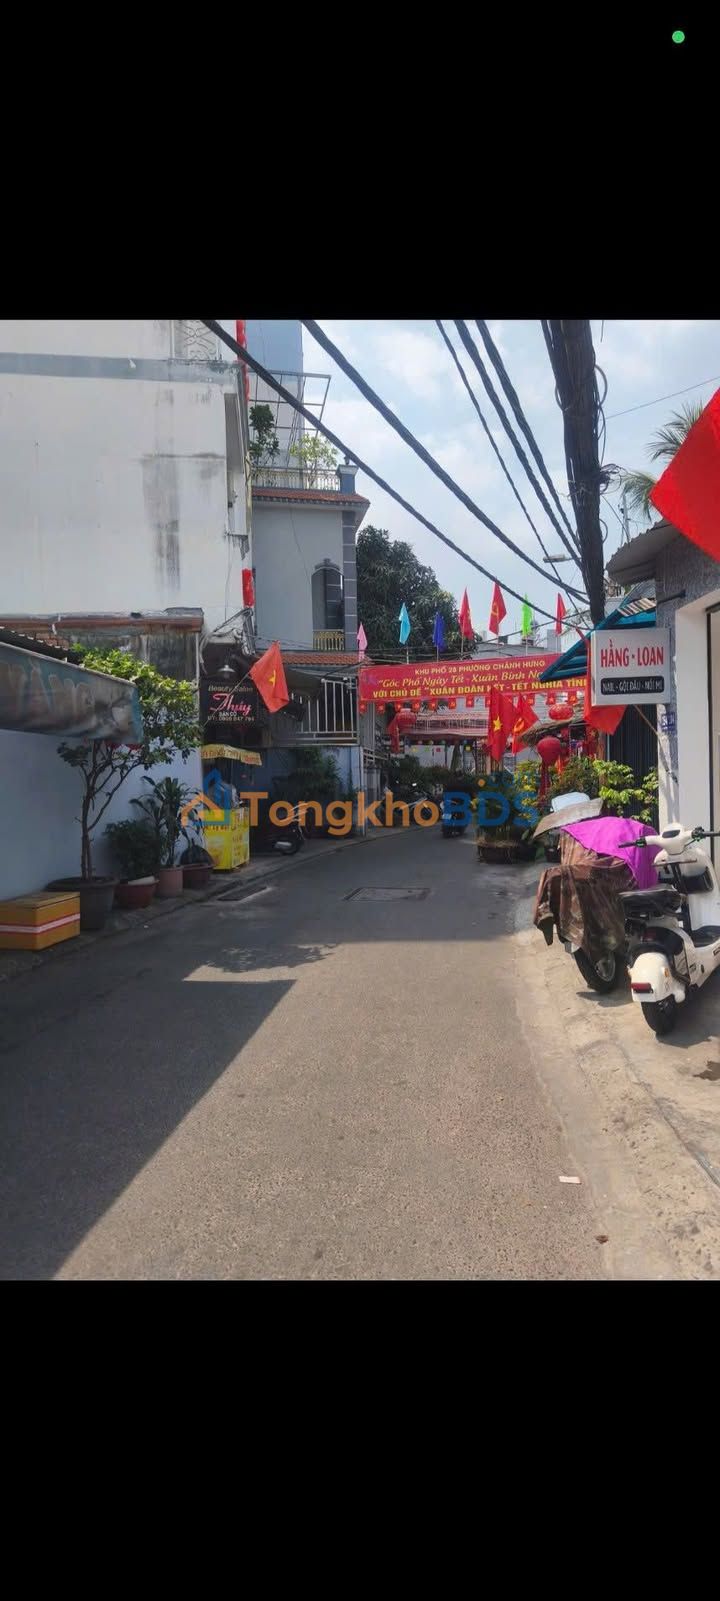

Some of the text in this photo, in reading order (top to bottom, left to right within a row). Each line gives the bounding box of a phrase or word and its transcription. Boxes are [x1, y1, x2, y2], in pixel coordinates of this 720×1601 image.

[637, 646, 664, 666] LOAN
[431, 665, 447, 675] PHỐ
[492, 661, 521, 671] CHÁNH
[402, 676, 421, 687] Phố
[422, 676, 449, 687] Ngày
[451, 673, 464, 684] Tết
[471, 673, 498, 682] Xuân
[602, 681, 615, 692] NAIL
[618, 680, 629, 693] GỘI
[373, 688, 388, 698] VỚI
[389, 687, 408, 697] CHỦ
[410, 687, 421, 696] ĐỀ
[457, 684, 484, 694] ĐOÀN
[511, 680, 529, 691] TẾT
